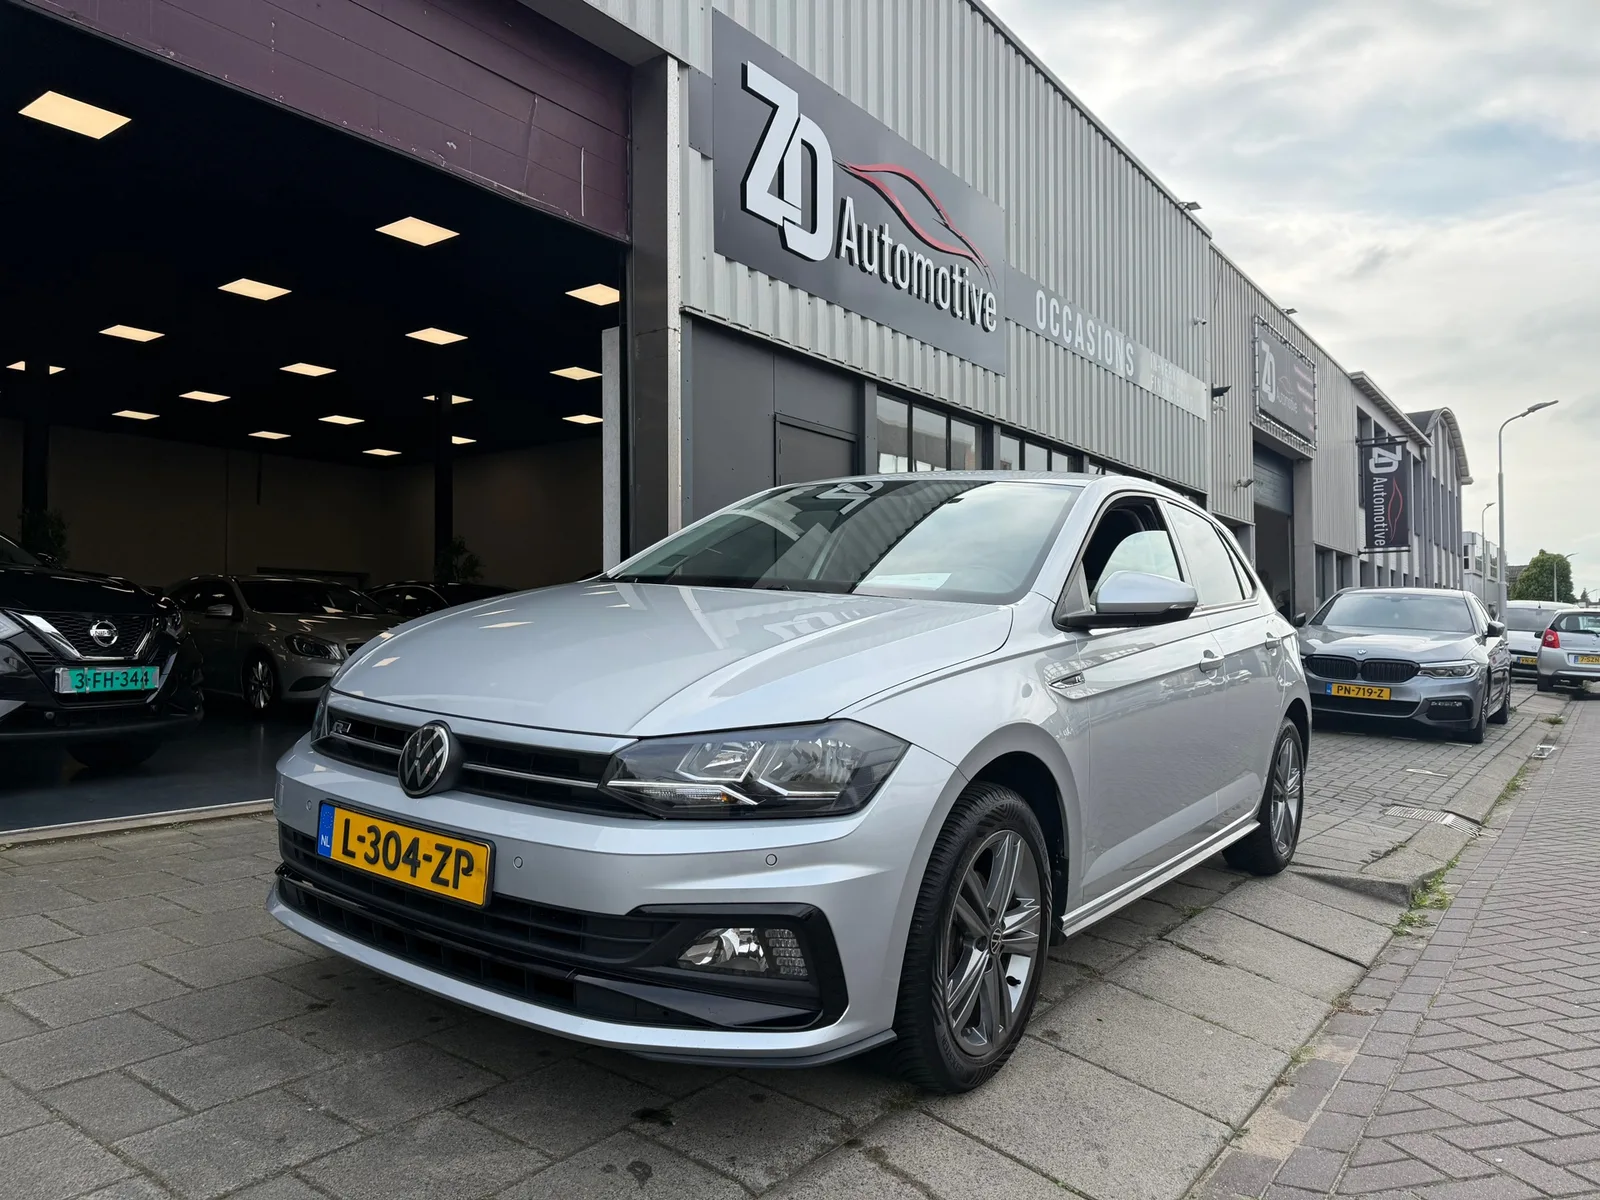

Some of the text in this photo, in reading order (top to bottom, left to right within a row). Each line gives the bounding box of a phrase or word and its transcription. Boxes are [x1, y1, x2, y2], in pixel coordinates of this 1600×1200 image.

[742, 60, 834, 261] ZD
[838, 196, 997, 333] Automotive
[1036, 289, 1134, 377] OCCASIONS
[1369, 445, 1402, 474] ZD
[1372, 477, 1388, 547] Automotive
[1337, 685, 1384, 699] PN-719-Z
[320, 834, 330, 848] NL
[341, 818, 475, 890] L-304-ZP
